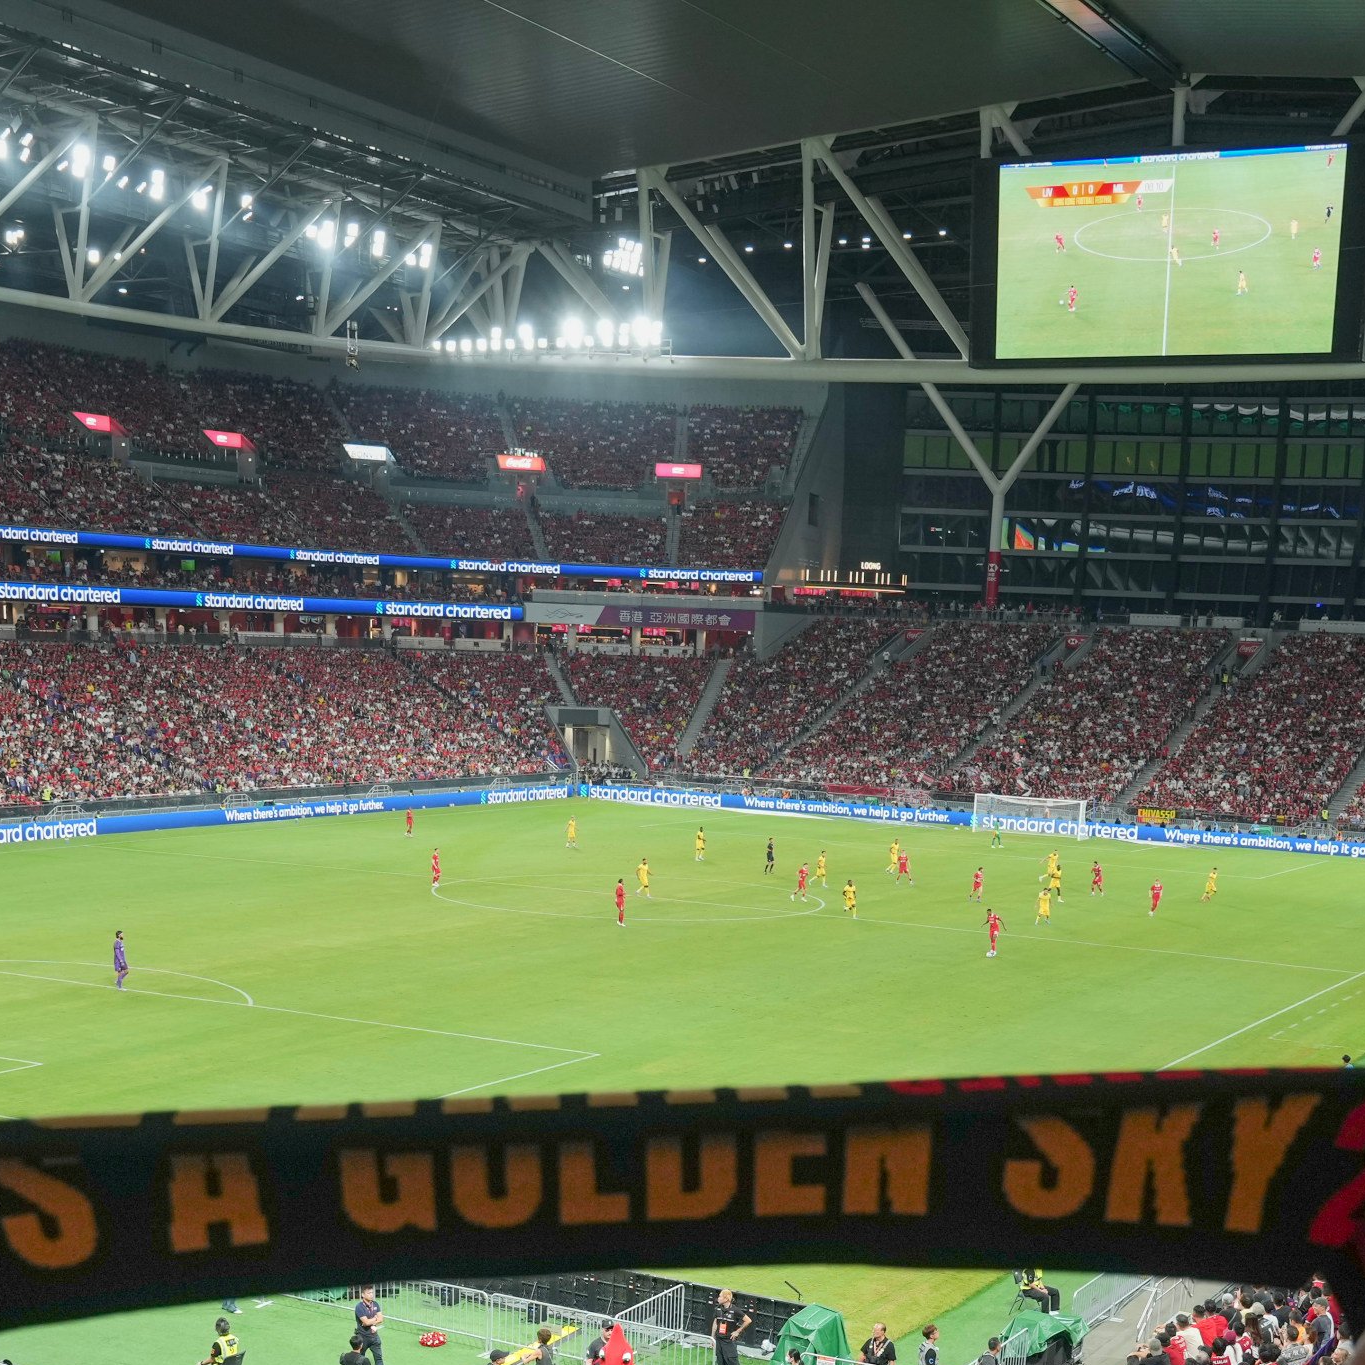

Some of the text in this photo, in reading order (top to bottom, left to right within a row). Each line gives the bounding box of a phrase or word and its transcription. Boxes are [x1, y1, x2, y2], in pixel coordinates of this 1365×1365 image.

[30, 529, 78, 544] chartered
[151, 540, 233, 555] standard chartered
[295, 550, 379, 565] standard chartered
[458, 559, 560, 575] standard chartered
[648, 568, 753, 582] standard chartered
[60, 588, 120, 604] chartered
[205, 594, 304, 611] standard chartered
[385, 601, 512, 620] standard chartered
[619, 610, 644, 623] 香港
[487, 785, 567, 804] standard chartered
[588, 783, 721, 808] standard chartered
[225, 800, 383, 821] Where there's ambition, we help it go further.
[743, 797, 950, 823] Where there's ambition, we help it go further.
[24, 818, 96, 841] chartered
[982, 815, 1137, 840] standard chartered
[1164, 830, 1201, 843] Where
[1202, 833, 1239, 846] there's
[1240, 836, 1295, 851] ambition,
[1296, 843, 1311, 851] we
[1313, 841, 1336, 857] help
[1340, 844, 1349, 854] it
[1351, 847, 1365, 858] go
